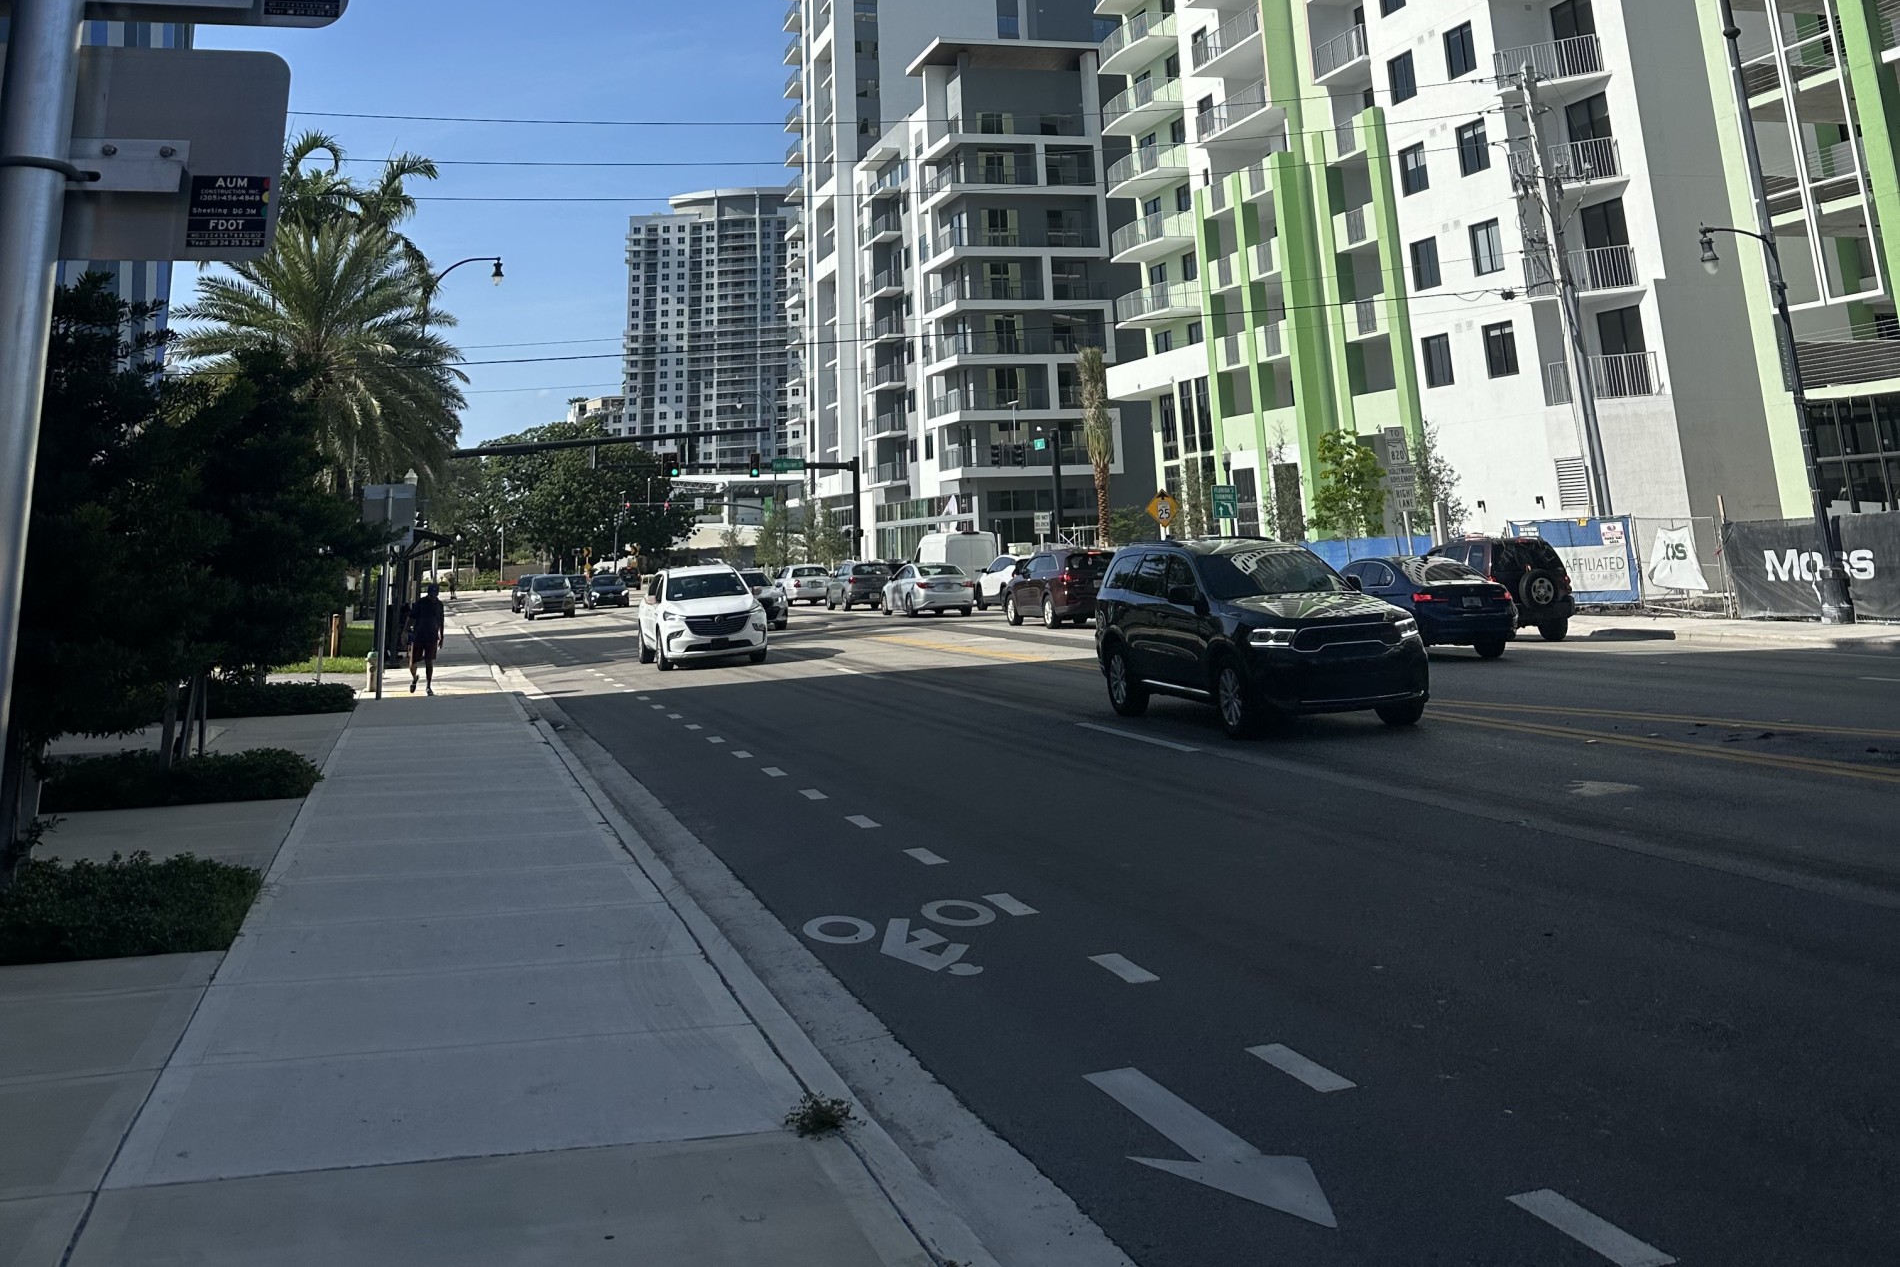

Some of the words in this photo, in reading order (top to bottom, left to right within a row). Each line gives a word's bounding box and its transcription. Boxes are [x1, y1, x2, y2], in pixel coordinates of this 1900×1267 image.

[215, 177, 248, 187] AUM
[209, 220, 245, 230] FDOT
[1391, 450, 1404, 460] 820
[1396, 489, 1413, 498] RIGHT
[1398, 499, 1414, 508] LANE
[1158, 508, 1170, 520] 25
[1566, 556, 1625, 571] AFFILIATED
